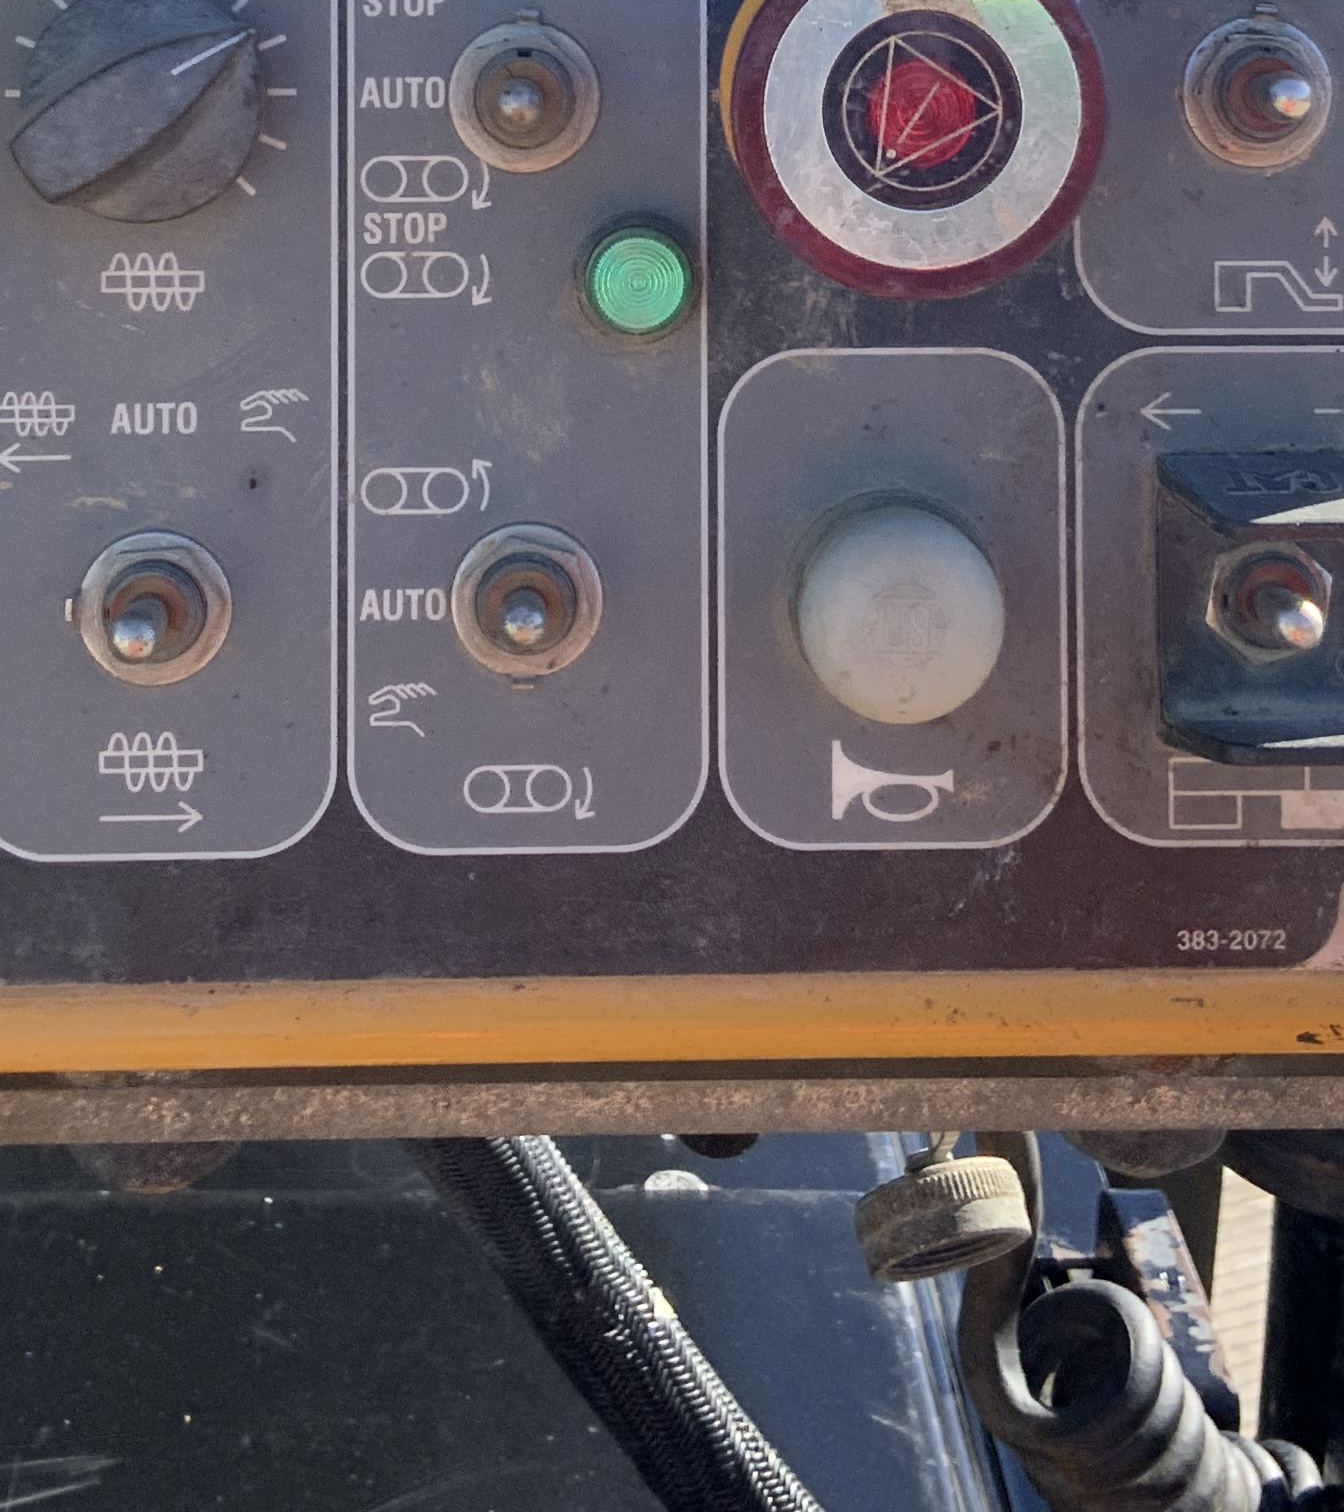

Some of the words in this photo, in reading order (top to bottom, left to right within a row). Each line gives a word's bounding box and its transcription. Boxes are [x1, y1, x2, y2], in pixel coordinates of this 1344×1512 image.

[360, 76, 446, 109] AUTO
[363, 212, 448, 245] STOP
[110, 401, 198, 435] AUTO
[359, 588, 448, 621] AUTO
[1176, 929, 1287, 950] 383-2072
